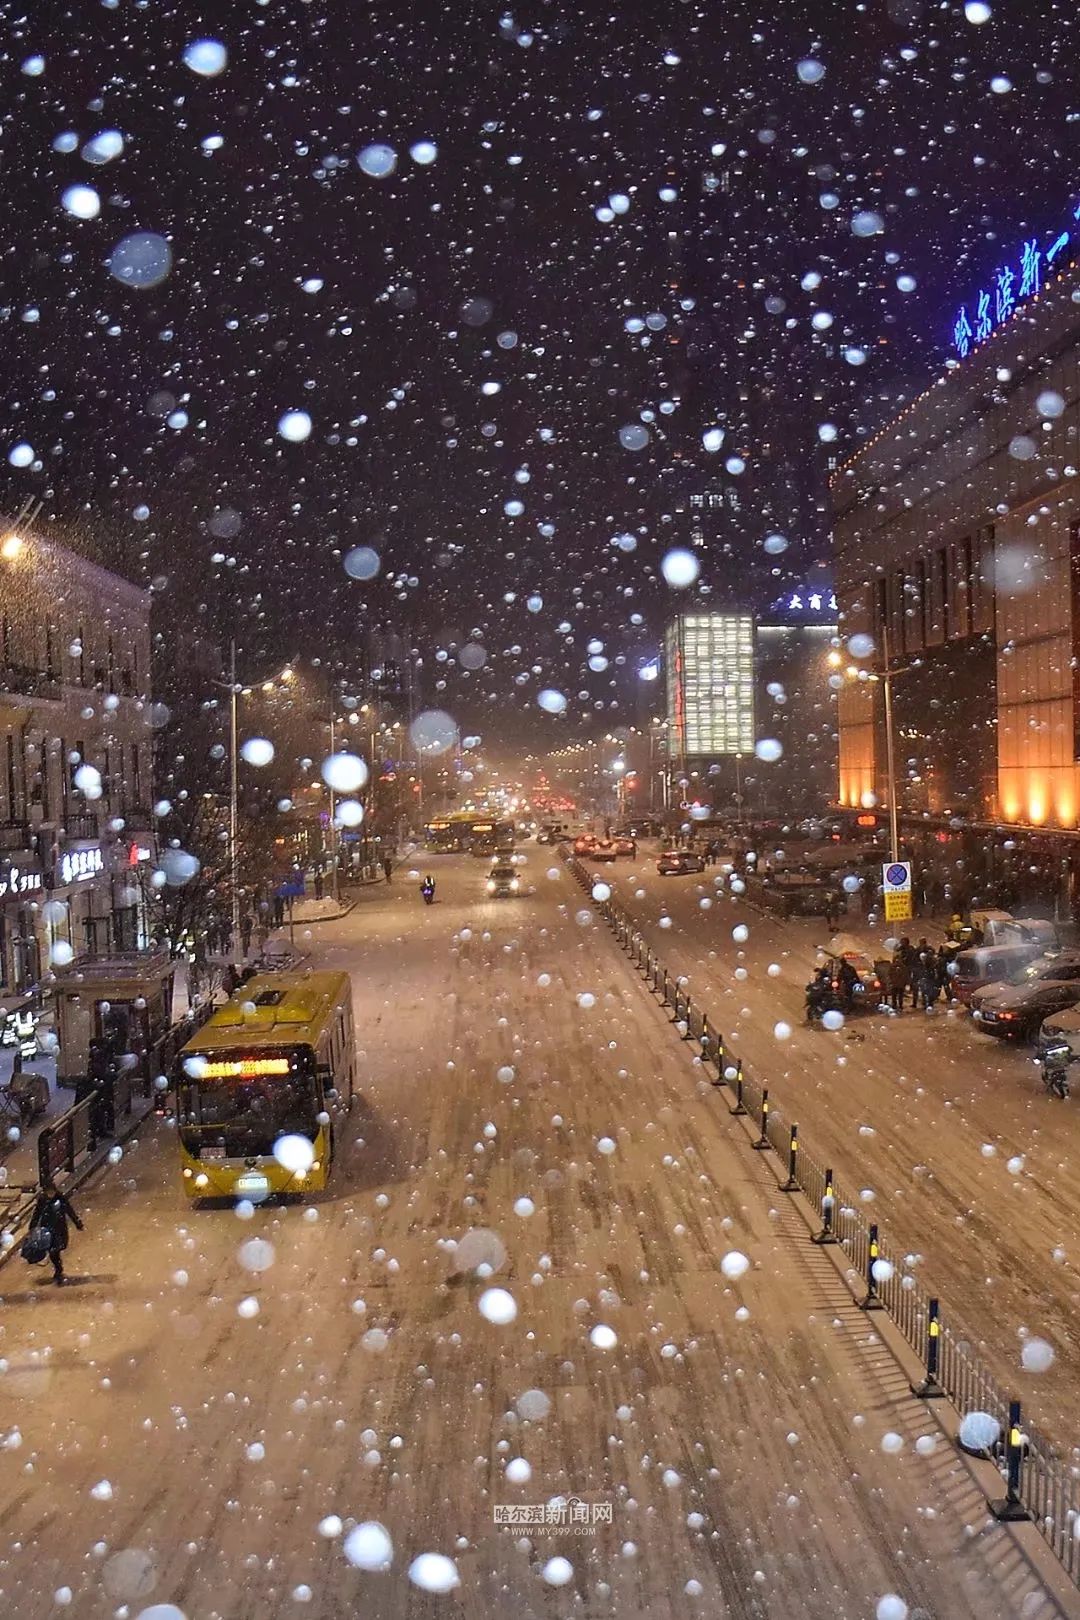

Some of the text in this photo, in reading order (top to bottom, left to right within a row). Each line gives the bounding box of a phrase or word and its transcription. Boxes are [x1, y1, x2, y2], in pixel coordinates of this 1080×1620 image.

[954, 204, 1080, 358] 哈尔滨新一
